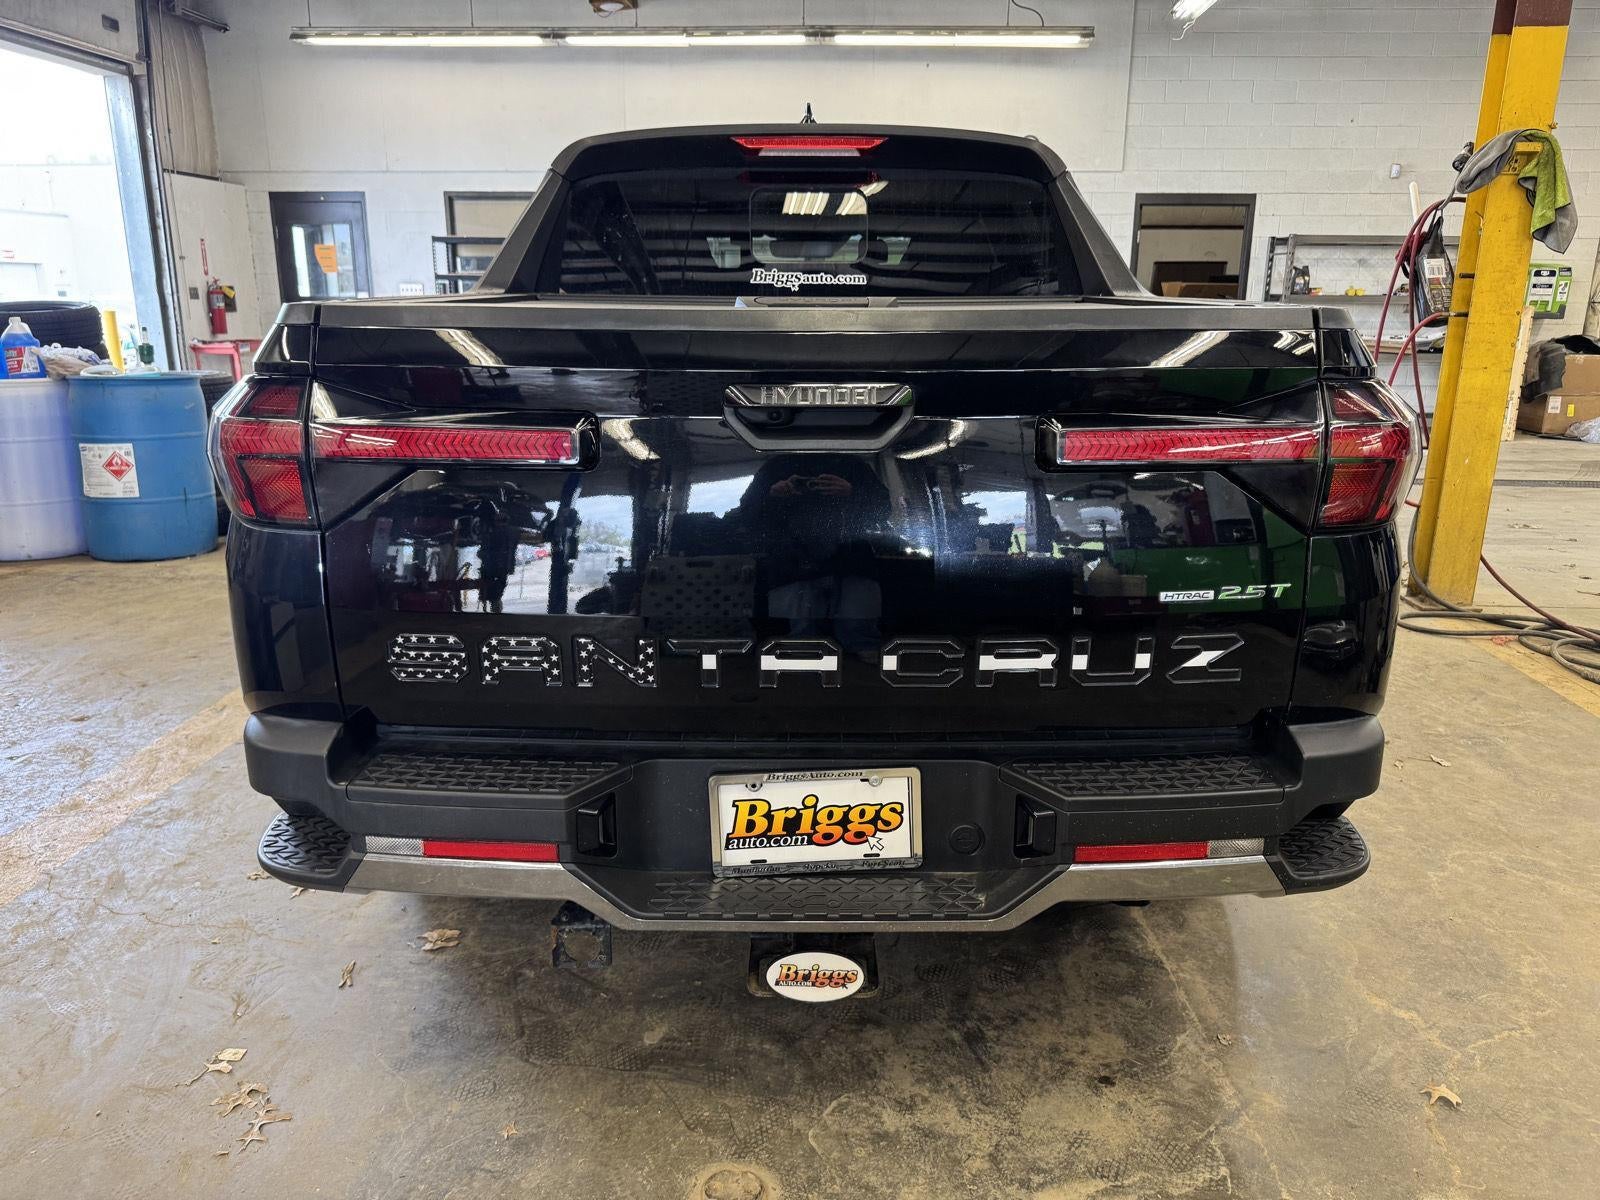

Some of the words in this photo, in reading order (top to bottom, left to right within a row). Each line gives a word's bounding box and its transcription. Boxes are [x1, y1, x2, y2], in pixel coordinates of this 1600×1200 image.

[750, 268, 867, 287] Briggsauto.com
[761, 386, 877, 405] HYUNDAI
[1162, 591, 1212, 601] HTRAC
[388, 632, 843, 689] SANTA
[880, 633, 1245, 689] CRUZ
[766, 770, 864, 782] BriggsAuto.com
[728, 793, 905, 847] Briggs
[728, 834, 809, 850] auto.com
[776, 963, 859, 988] Briggs
[778, 979, 813, 987] AUTO.COM
